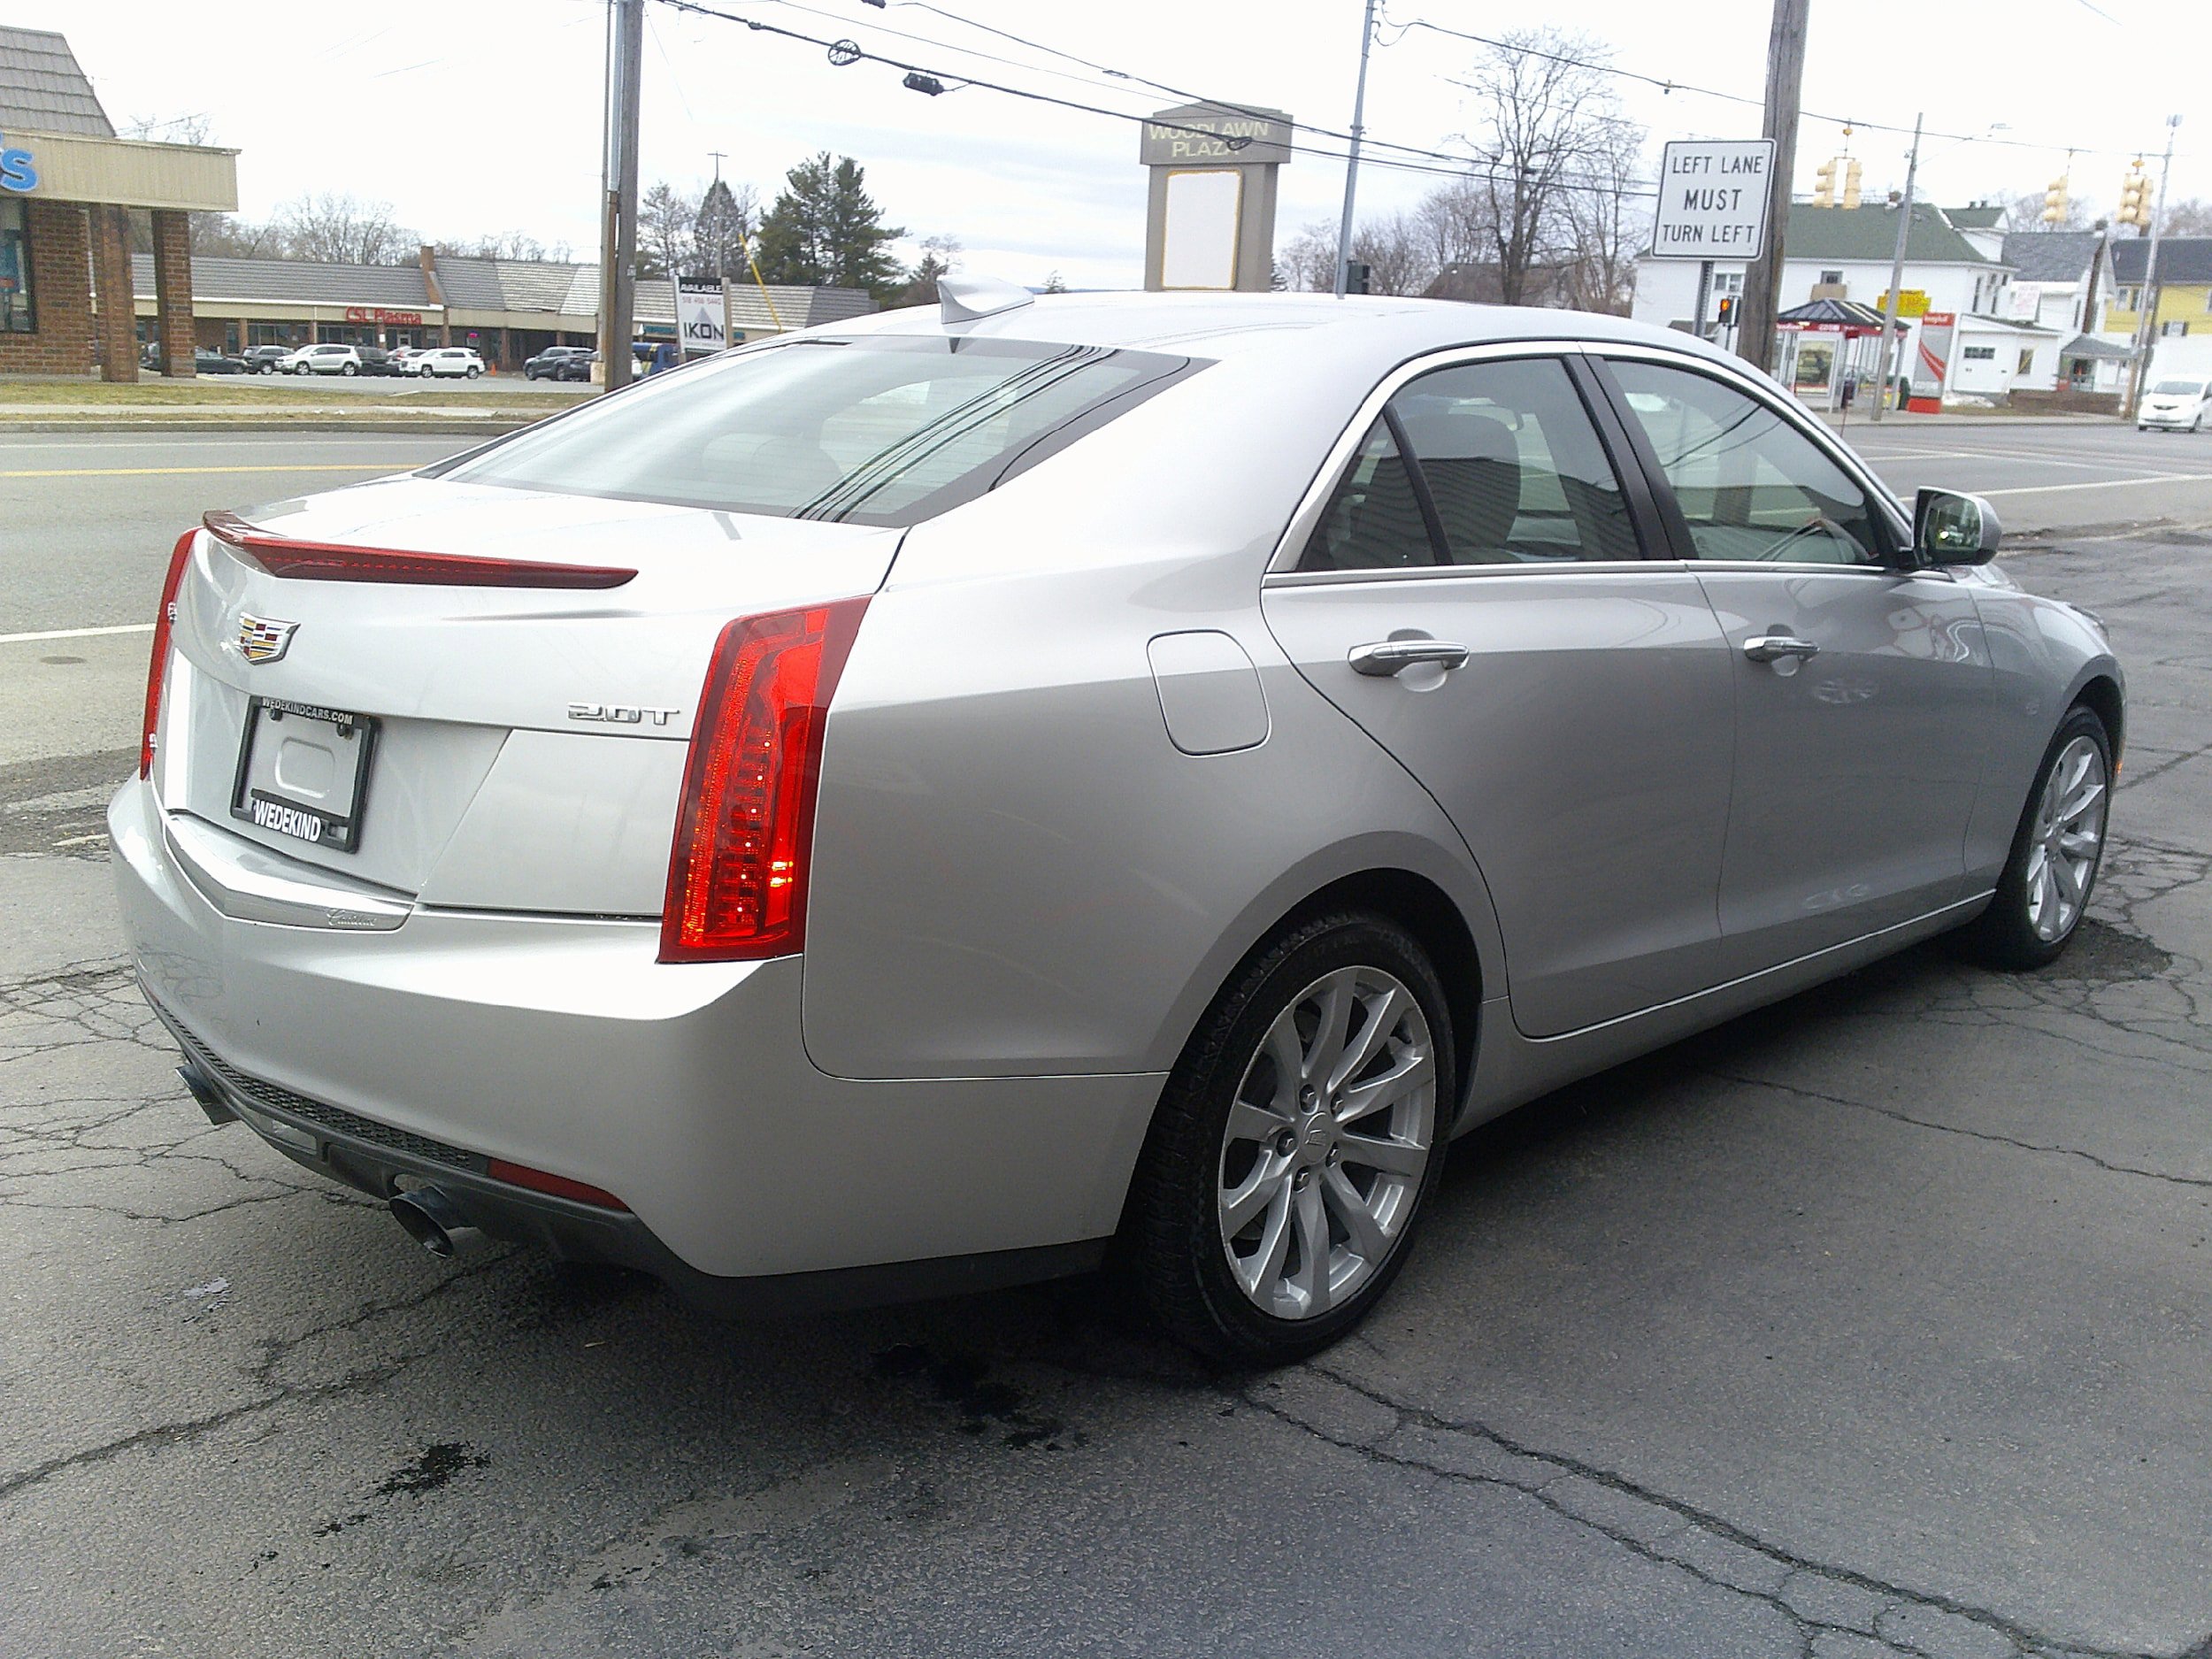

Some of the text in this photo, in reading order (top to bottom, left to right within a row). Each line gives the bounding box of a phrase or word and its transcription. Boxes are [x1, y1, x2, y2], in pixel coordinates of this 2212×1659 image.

[1149, 122, 1269, 140] WOODLAWN
[1672, 156, 1763, 173] LEFT LANE
[1684, 188, 1742, 211] MUST
[1663, 225, 1755, 243] TURN LEFT
[680, 283, 722, 294] AVAILABLE
[346, 306, 422, 326] CSL Plasma
[684, 321, 725, 341] IKON
[262, 696, 353, 726] WEDEKINDCARS.COM
[254, 799, 322, 842] WEDEKIND
